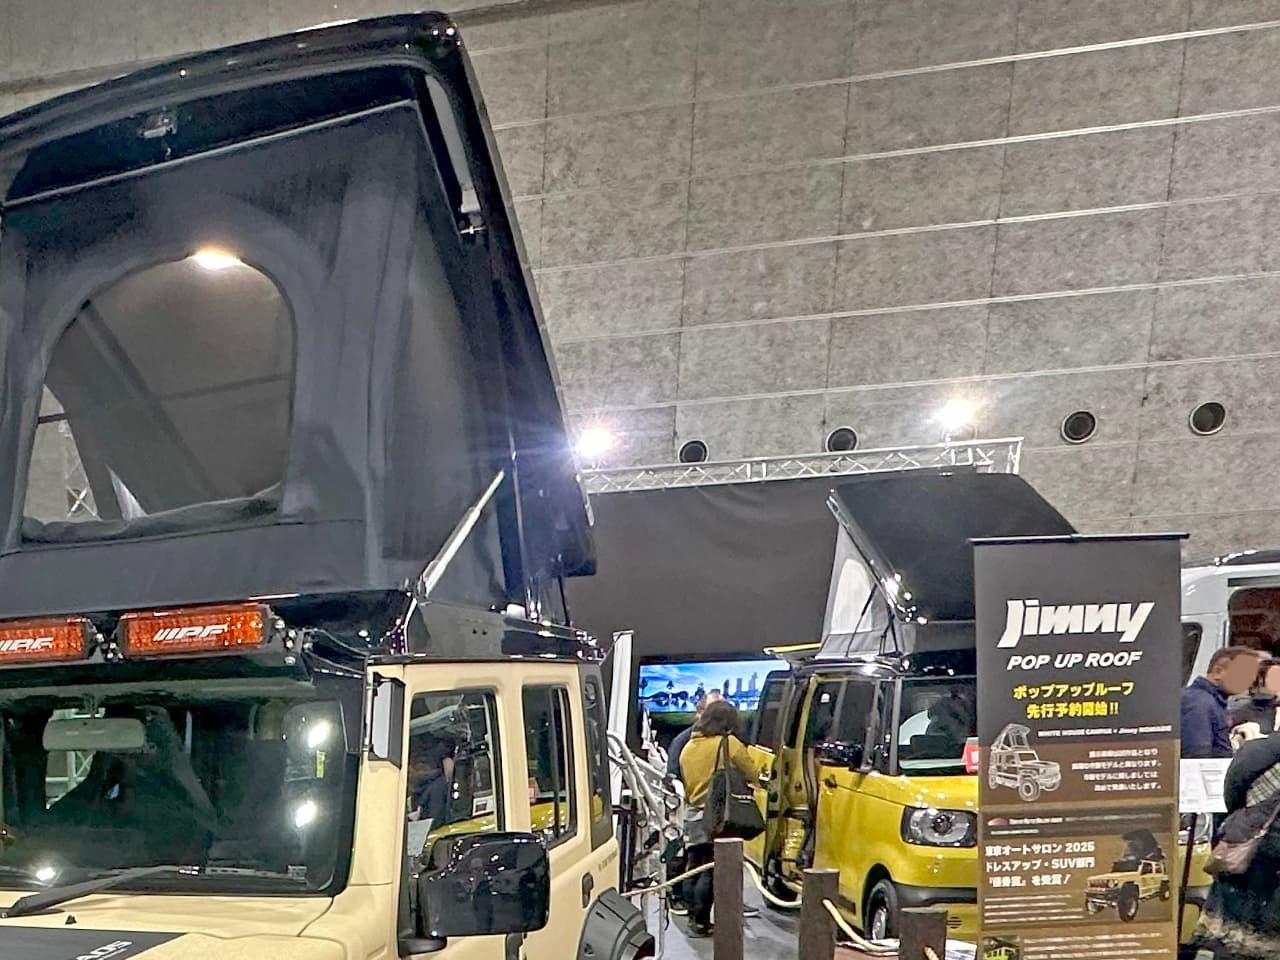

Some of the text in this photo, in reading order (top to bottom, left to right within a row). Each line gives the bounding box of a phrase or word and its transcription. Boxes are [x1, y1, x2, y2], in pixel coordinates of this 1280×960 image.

[996, 599, 1155, 648] Jimny
[1007, 651, 1143, 671] POP UP ROOF
[985, 841, 1095, 857] 東京オートサロン 2025
